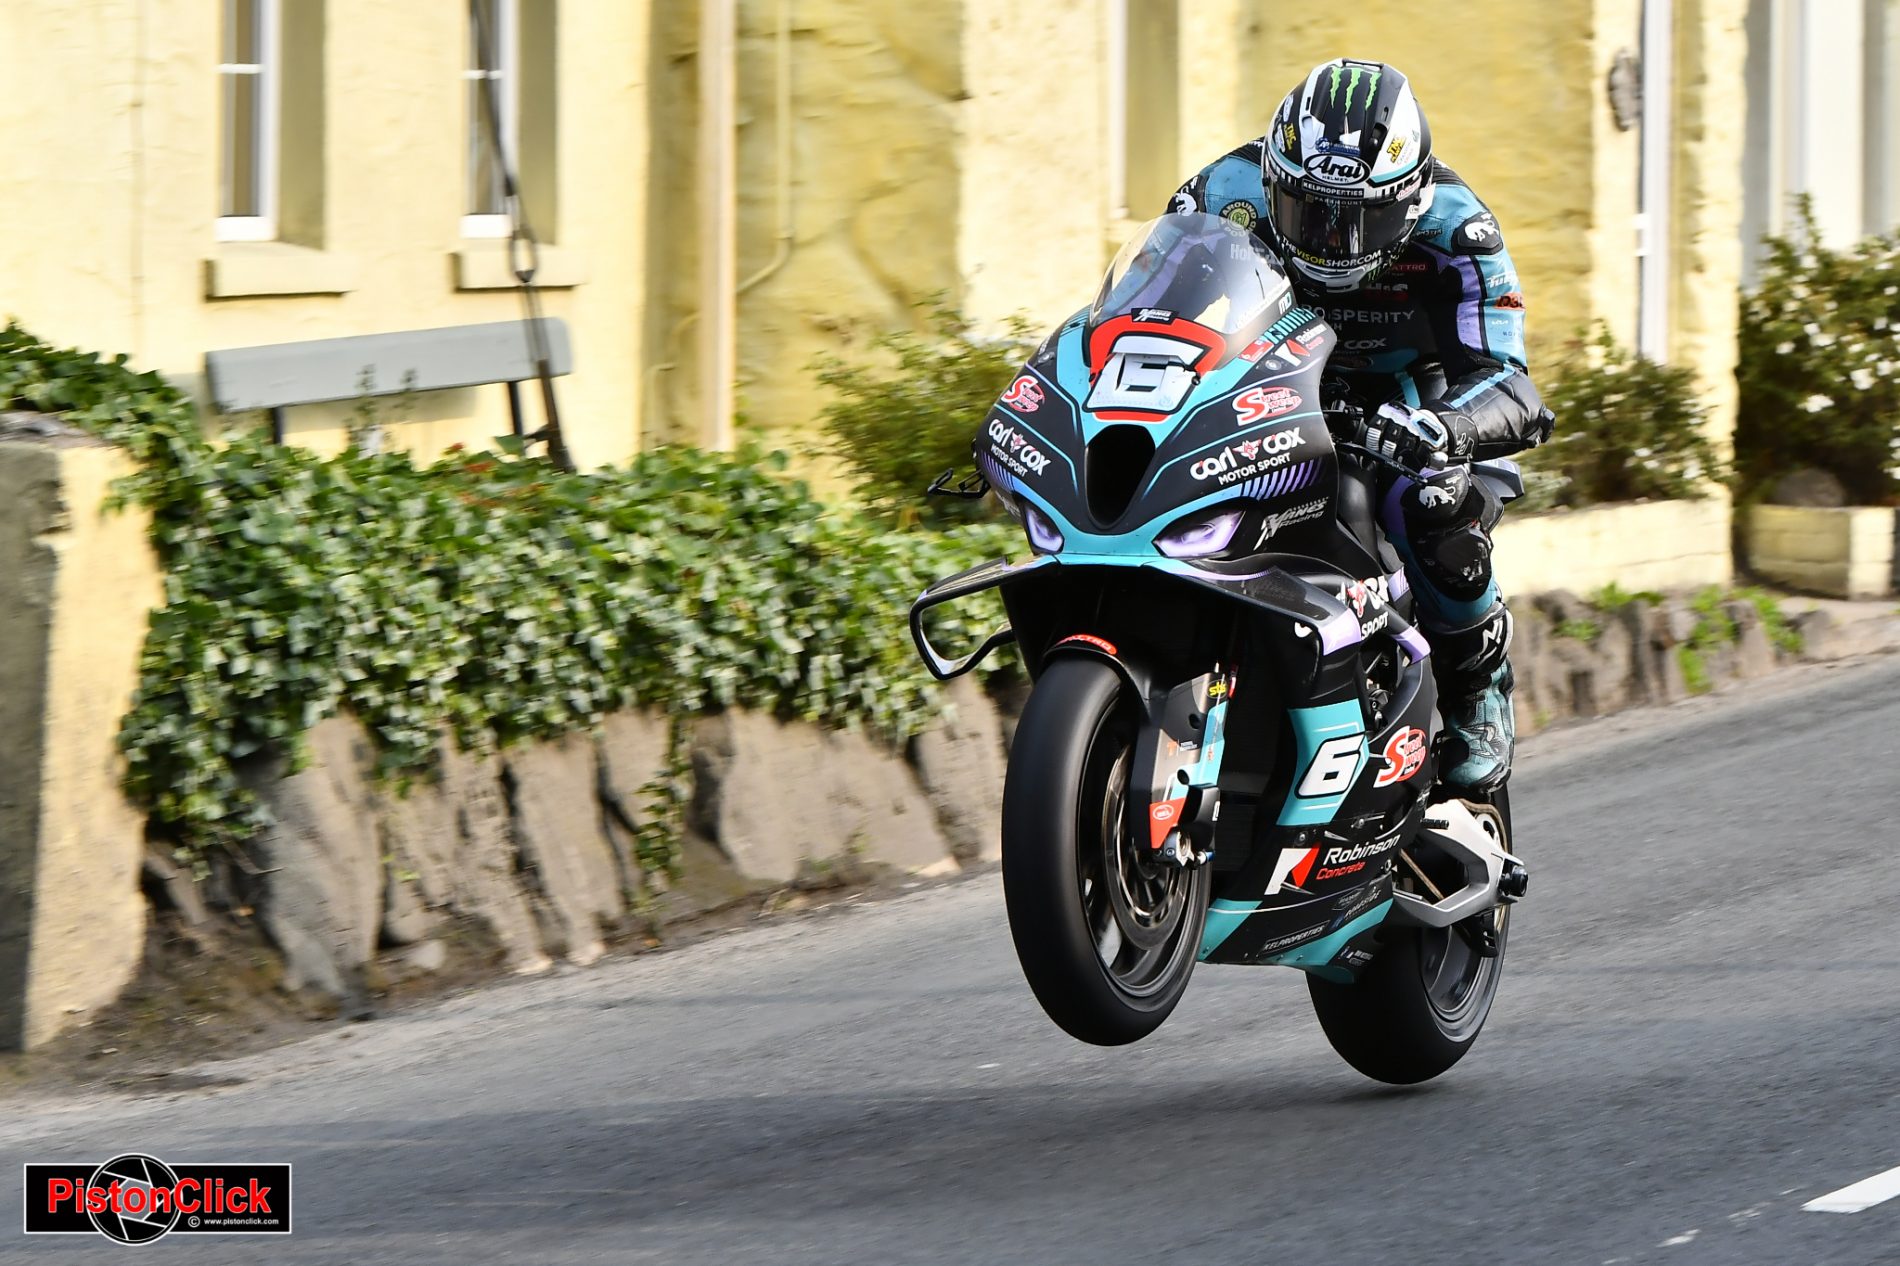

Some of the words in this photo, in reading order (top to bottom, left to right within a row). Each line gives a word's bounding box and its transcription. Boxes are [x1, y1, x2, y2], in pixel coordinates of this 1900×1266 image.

[1307, 156, 1361, 179] Arai
[1303, 181, 1363, 196] KELPROPERTIES
[1222, 202, 1257, 219] AROUND
[991, 443, 1009, 464] MOTOR
[1007, 457, 1028, 477] SPORT
[1218, 464, 1257, 485] MOTOR
[1257, 452, 1290, 471] SPORT
[1299, 733, 1368, 800] 6
[1323, 834, 1400, 866] Robinson
[1316, 861, 1367, 880] Concrete
